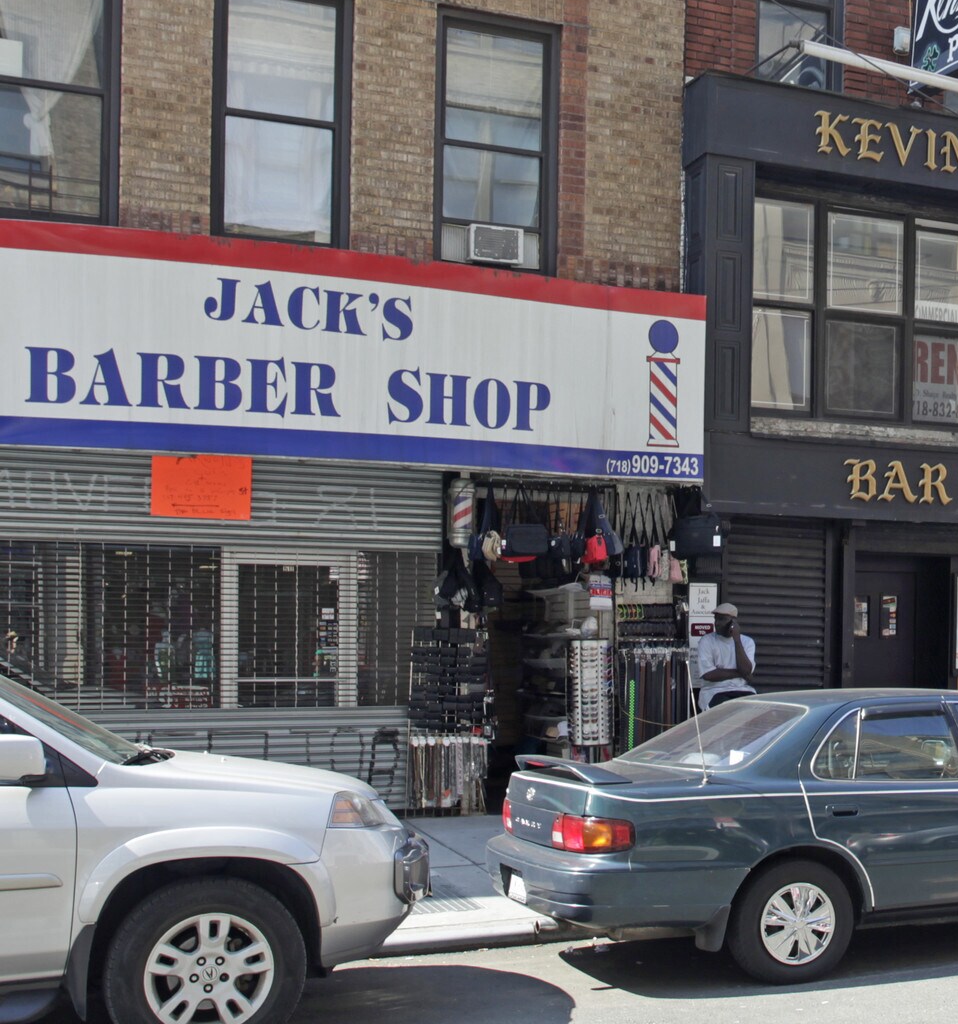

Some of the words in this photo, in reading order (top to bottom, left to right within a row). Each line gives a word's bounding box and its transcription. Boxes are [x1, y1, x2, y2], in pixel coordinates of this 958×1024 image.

[204, 278, 413, 341] JACK'S
[25, 346, 341, 418] BARBER
[387, 366, 551, 431] SHOP
[844, 458, 952, 507] BAR
